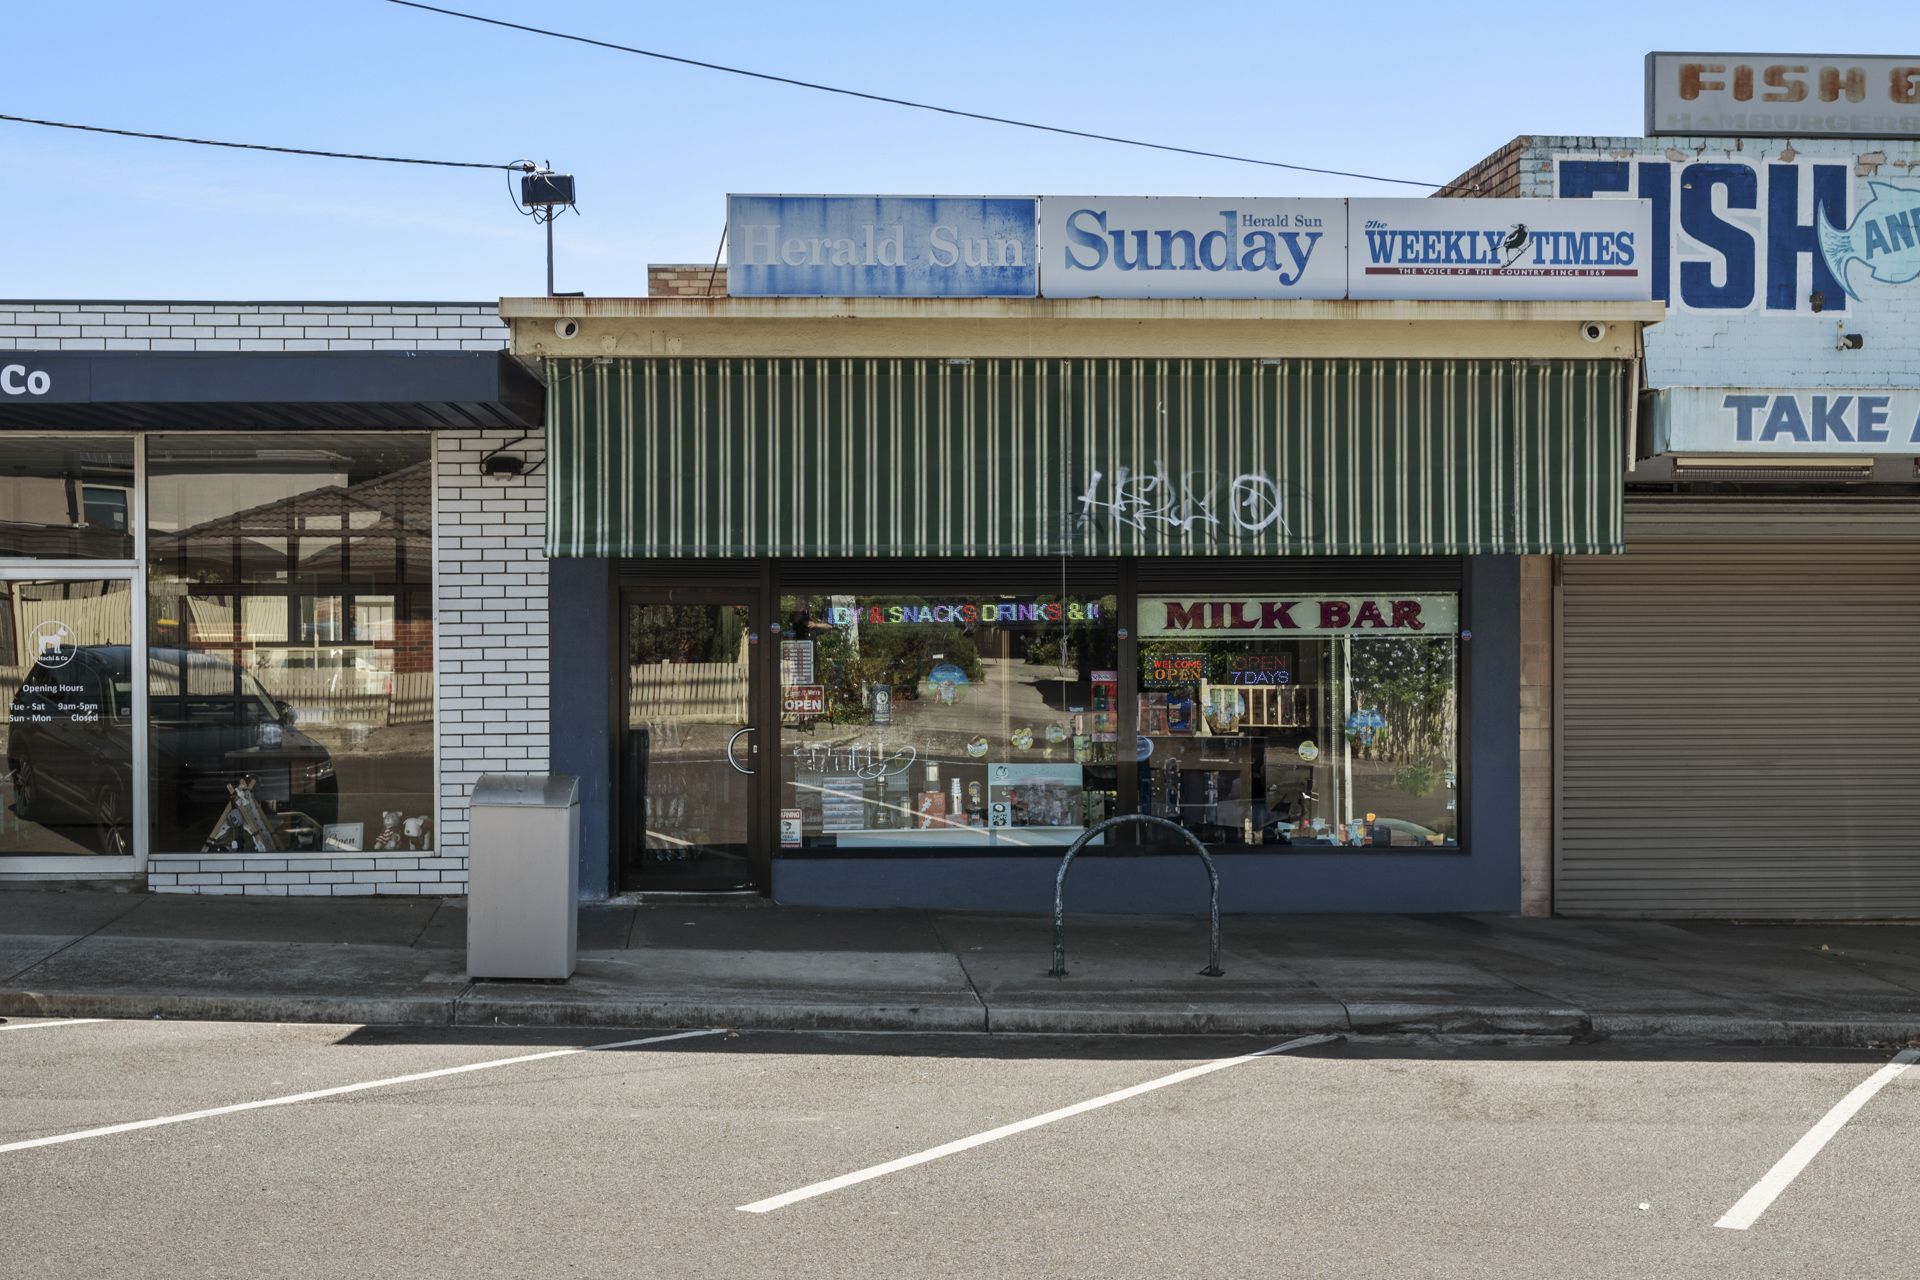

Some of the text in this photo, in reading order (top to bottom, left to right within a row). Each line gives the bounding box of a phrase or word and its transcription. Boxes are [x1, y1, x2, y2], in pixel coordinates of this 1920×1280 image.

[1678, 63, 1866, 102] FISH
[1241, 214, 1323, 228] Herald Sun
[1365, 220, 1387, 229] The
[740, 223, 1027, 267] Herald Sun
[1064, 208, 1324, 286] Sunday
[1365, 230, 1635, 266] WEEKLY TIMES
[1457, 268, 1471, 276] OF
[1475, 268, 1493, 276] THE
[1499, 268, 1546, 276] COUNTRY
[0, 364, 51, 395] Co
[1722, 394, 1891, 443] TAKE
[889, 604, 977, 623] SNACKS
[982, 603, 1061, 621] DRINKS
[1068, 602, 1085, 620] &
[1162, 600, 1426, 630] MILK BAR
[1153, 659, 1202, 669] WELCOME
[1231, 655, 1287, 671] OPEN
[1154, 669, 1201, 681] OPEN
[1231, 671, 1289, 685] 7 DAYS
[22, 684, 84, 693] Opening Hours
[9, 702, 25, 710] Tue
[31, 702, 45, 710] Sat
[57, 702, 98, 711] 9am-5pm
[784, 699, 822, 710] OPEN
[9, 714, 25, 722] Sun
[32, 714, 51, 722] Mon
[71, 713, 98, 722] Closed
